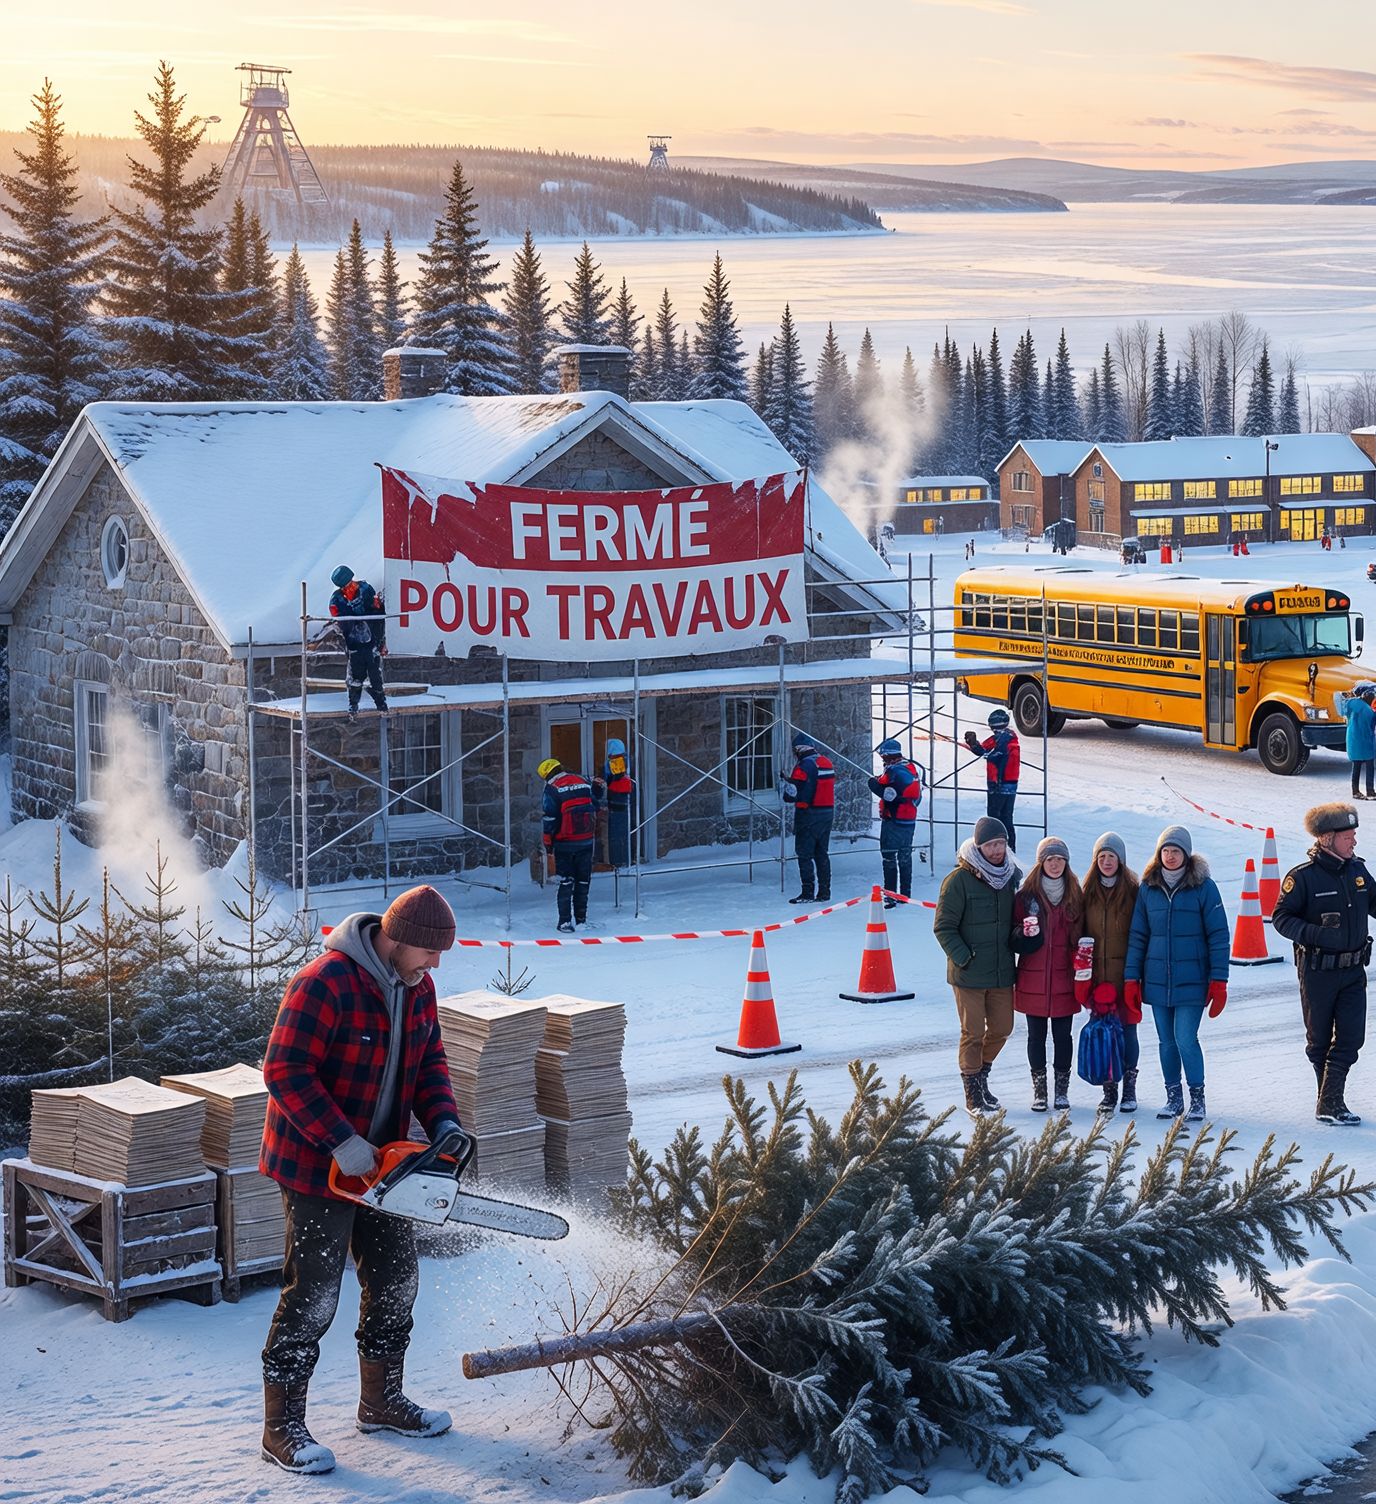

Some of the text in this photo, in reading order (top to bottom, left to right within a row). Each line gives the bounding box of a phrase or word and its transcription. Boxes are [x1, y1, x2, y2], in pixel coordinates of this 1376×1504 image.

[509, 489, 711, 562] FERMÉ
[399, 569, 792, 641] POUR TRAVAUX
